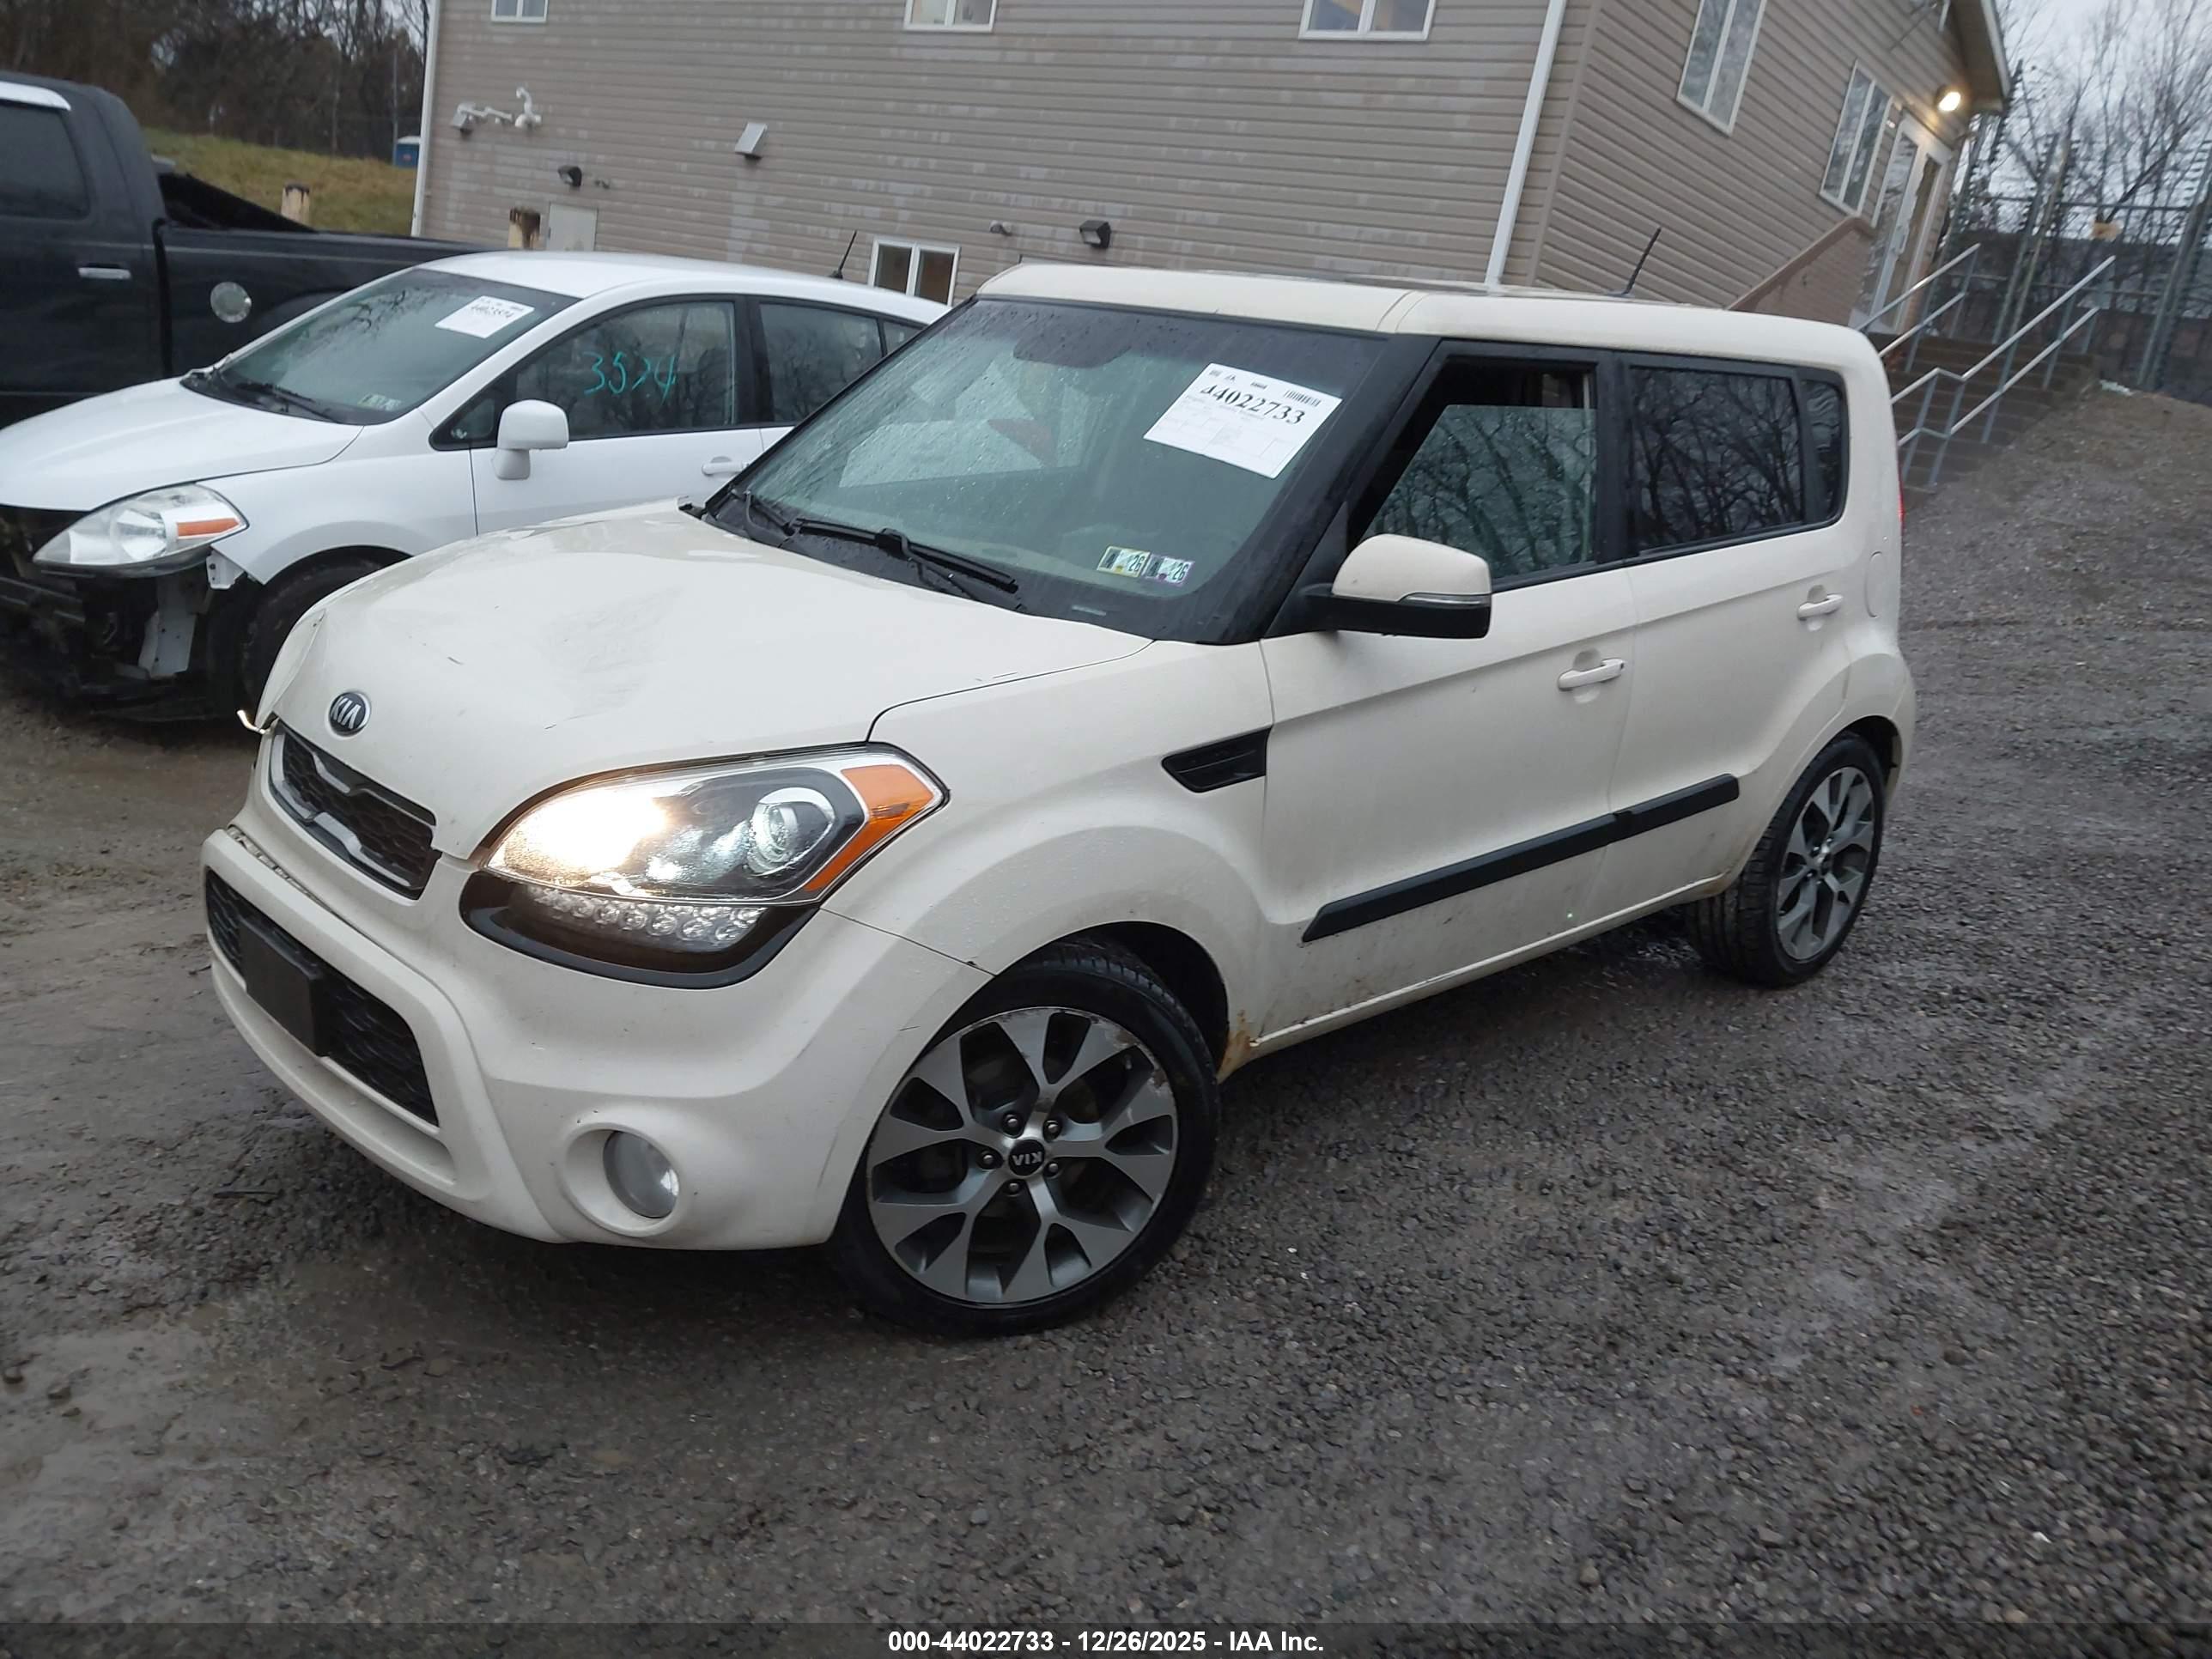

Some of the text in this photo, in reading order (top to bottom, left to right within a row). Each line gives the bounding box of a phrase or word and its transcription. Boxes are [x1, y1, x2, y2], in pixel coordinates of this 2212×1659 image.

[1200, 385, 1305, 424] 44022733
[331, 696, 362, 730] KIA
[1012, 1152, 1042, 1166] KIA
